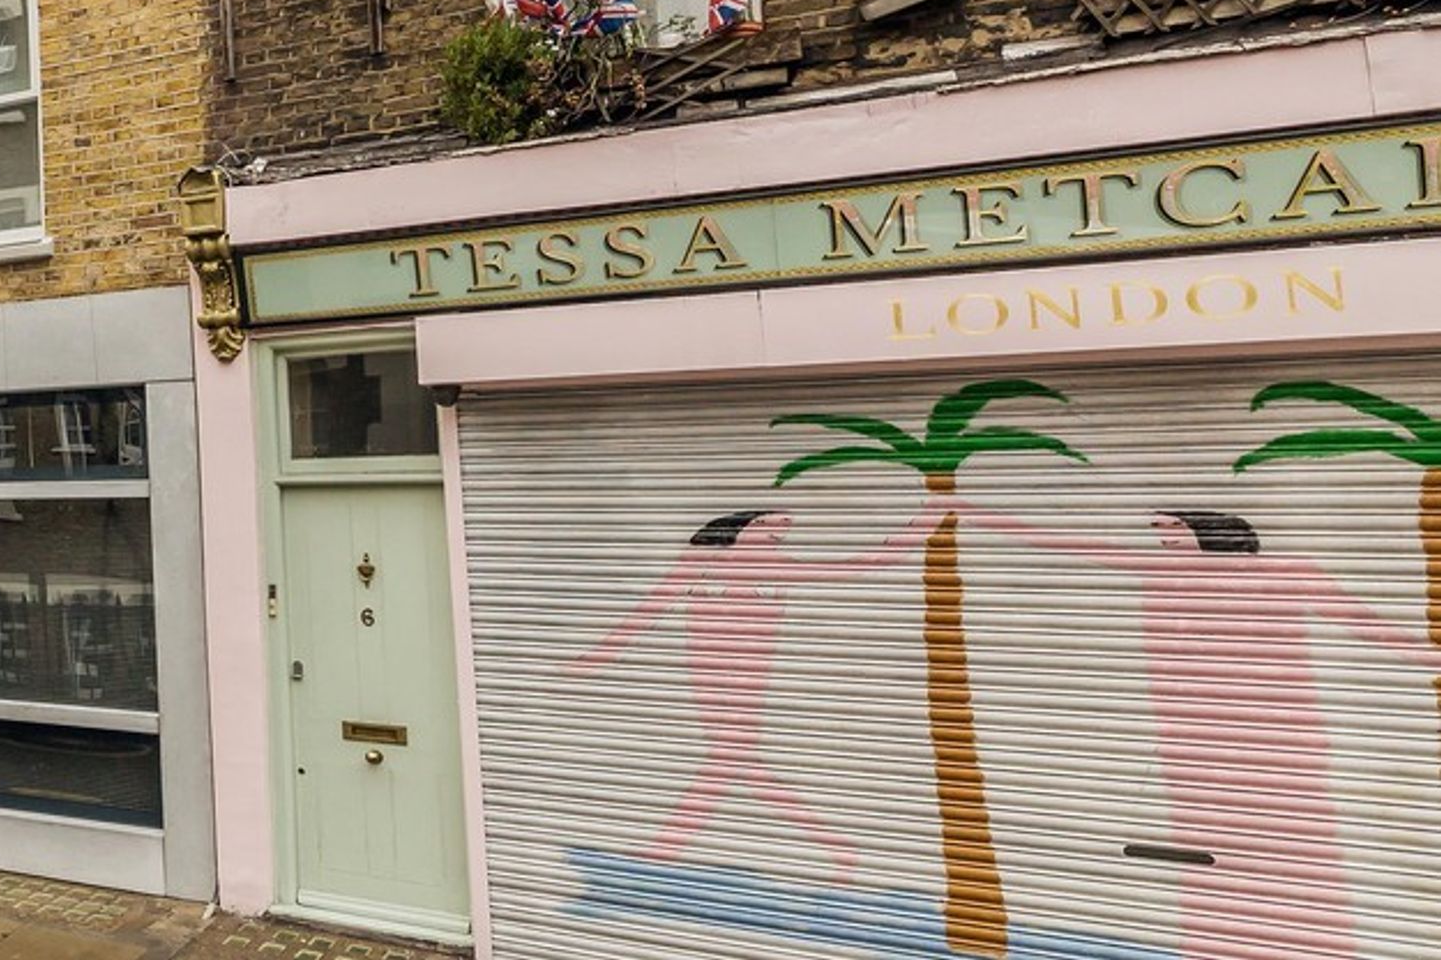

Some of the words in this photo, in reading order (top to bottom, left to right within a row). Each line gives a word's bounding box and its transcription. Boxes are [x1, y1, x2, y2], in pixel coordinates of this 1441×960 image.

[390, 214, 748, 299] TESSA
[888, 266, 1345, 341] LONDON
[361, 607, 375, 627] 6
